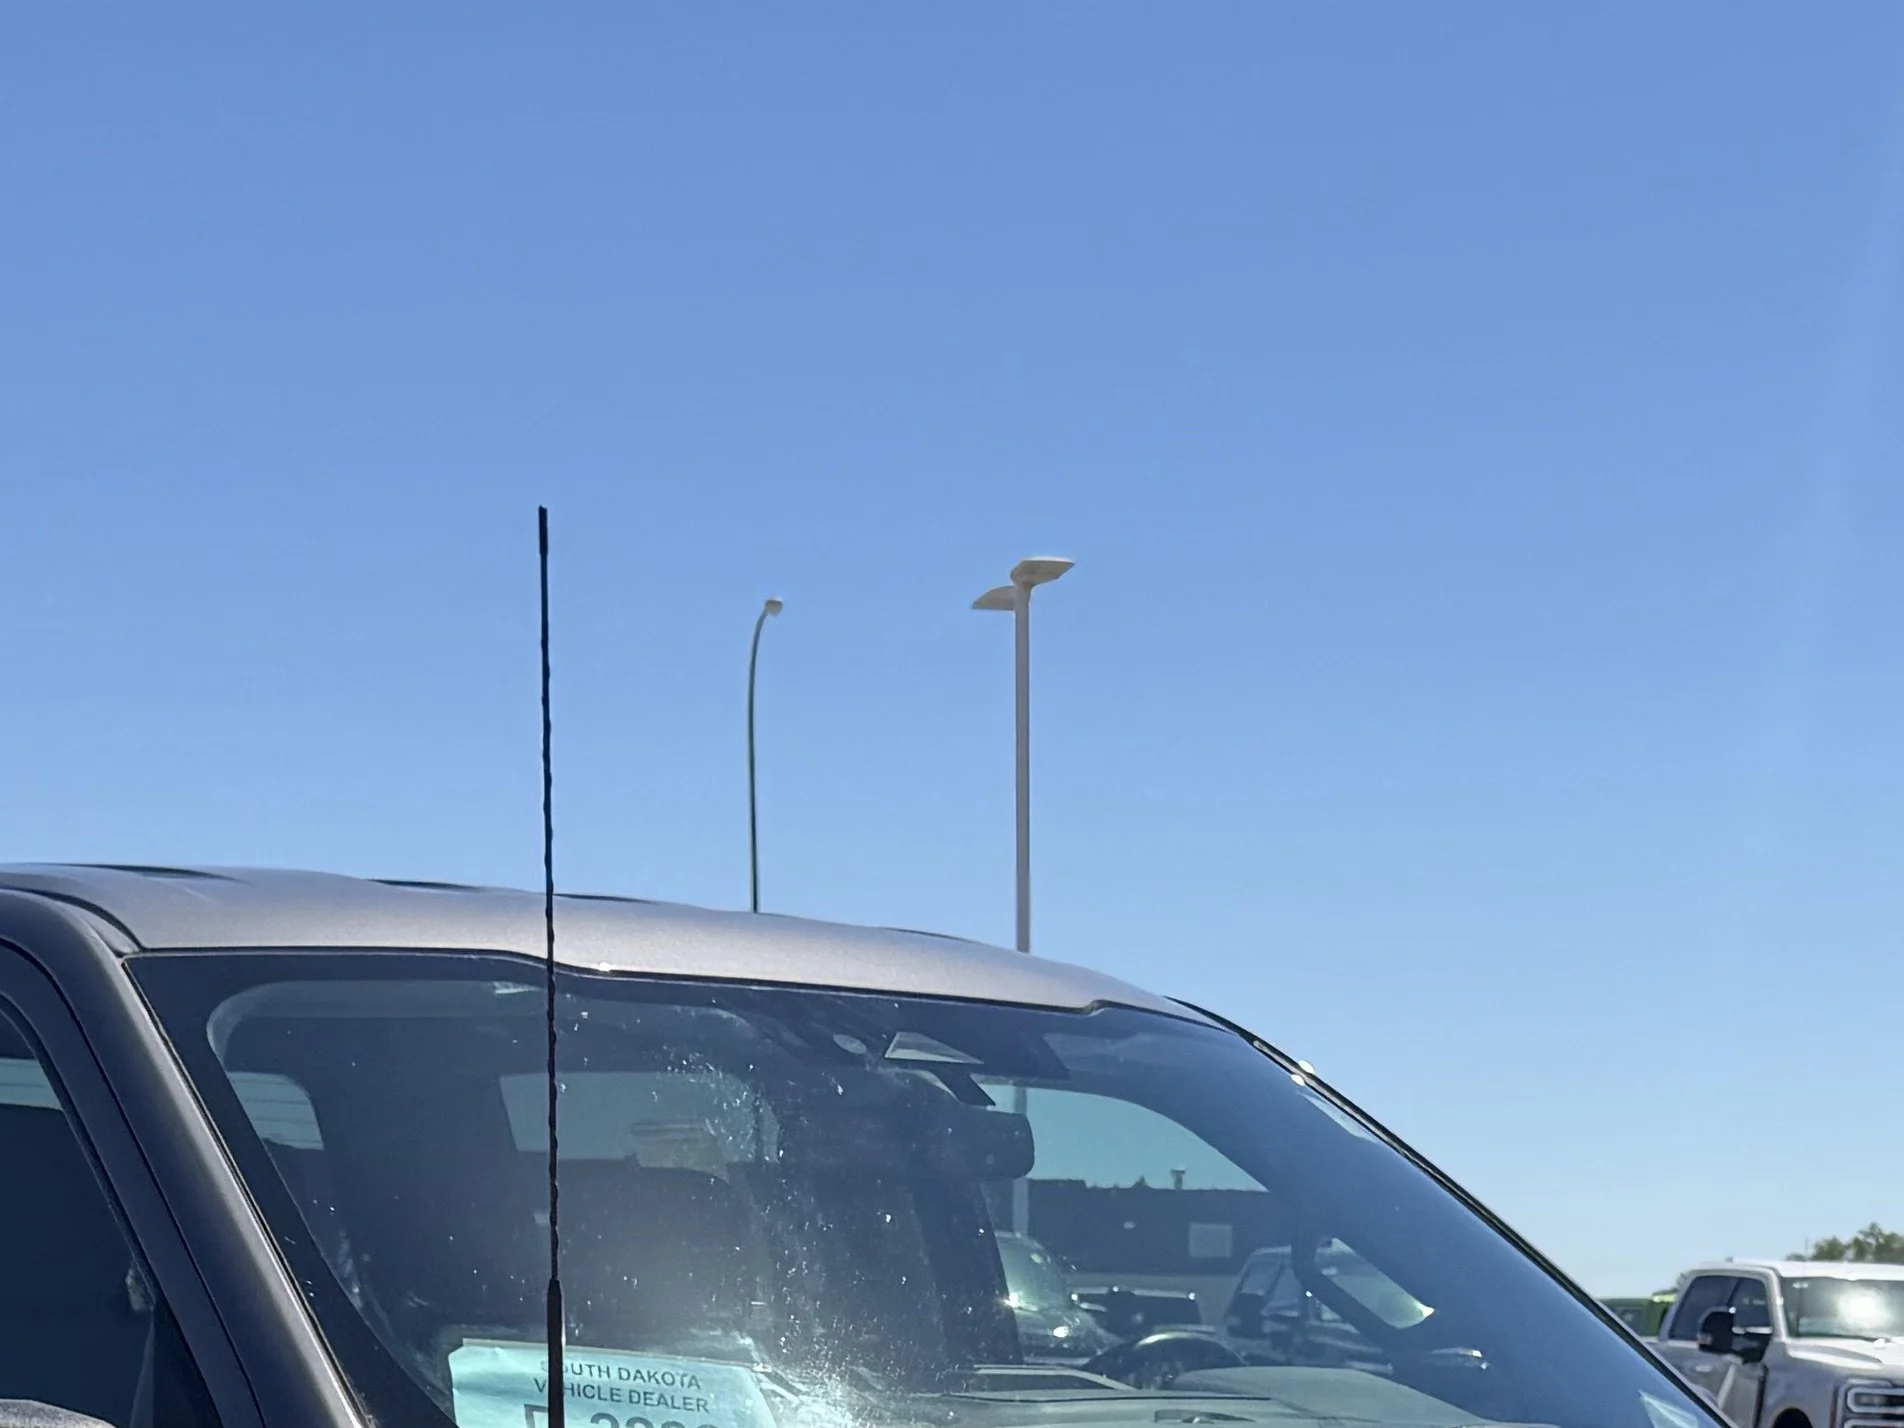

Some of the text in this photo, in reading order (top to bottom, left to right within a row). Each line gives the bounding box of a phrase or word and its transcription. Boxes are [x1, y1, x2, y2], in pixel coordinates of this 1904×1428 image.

[540, 1359, 702, 1390] SUTH DAKOTA
[533, 1377, 710, 1414] VHICLE DEALER
